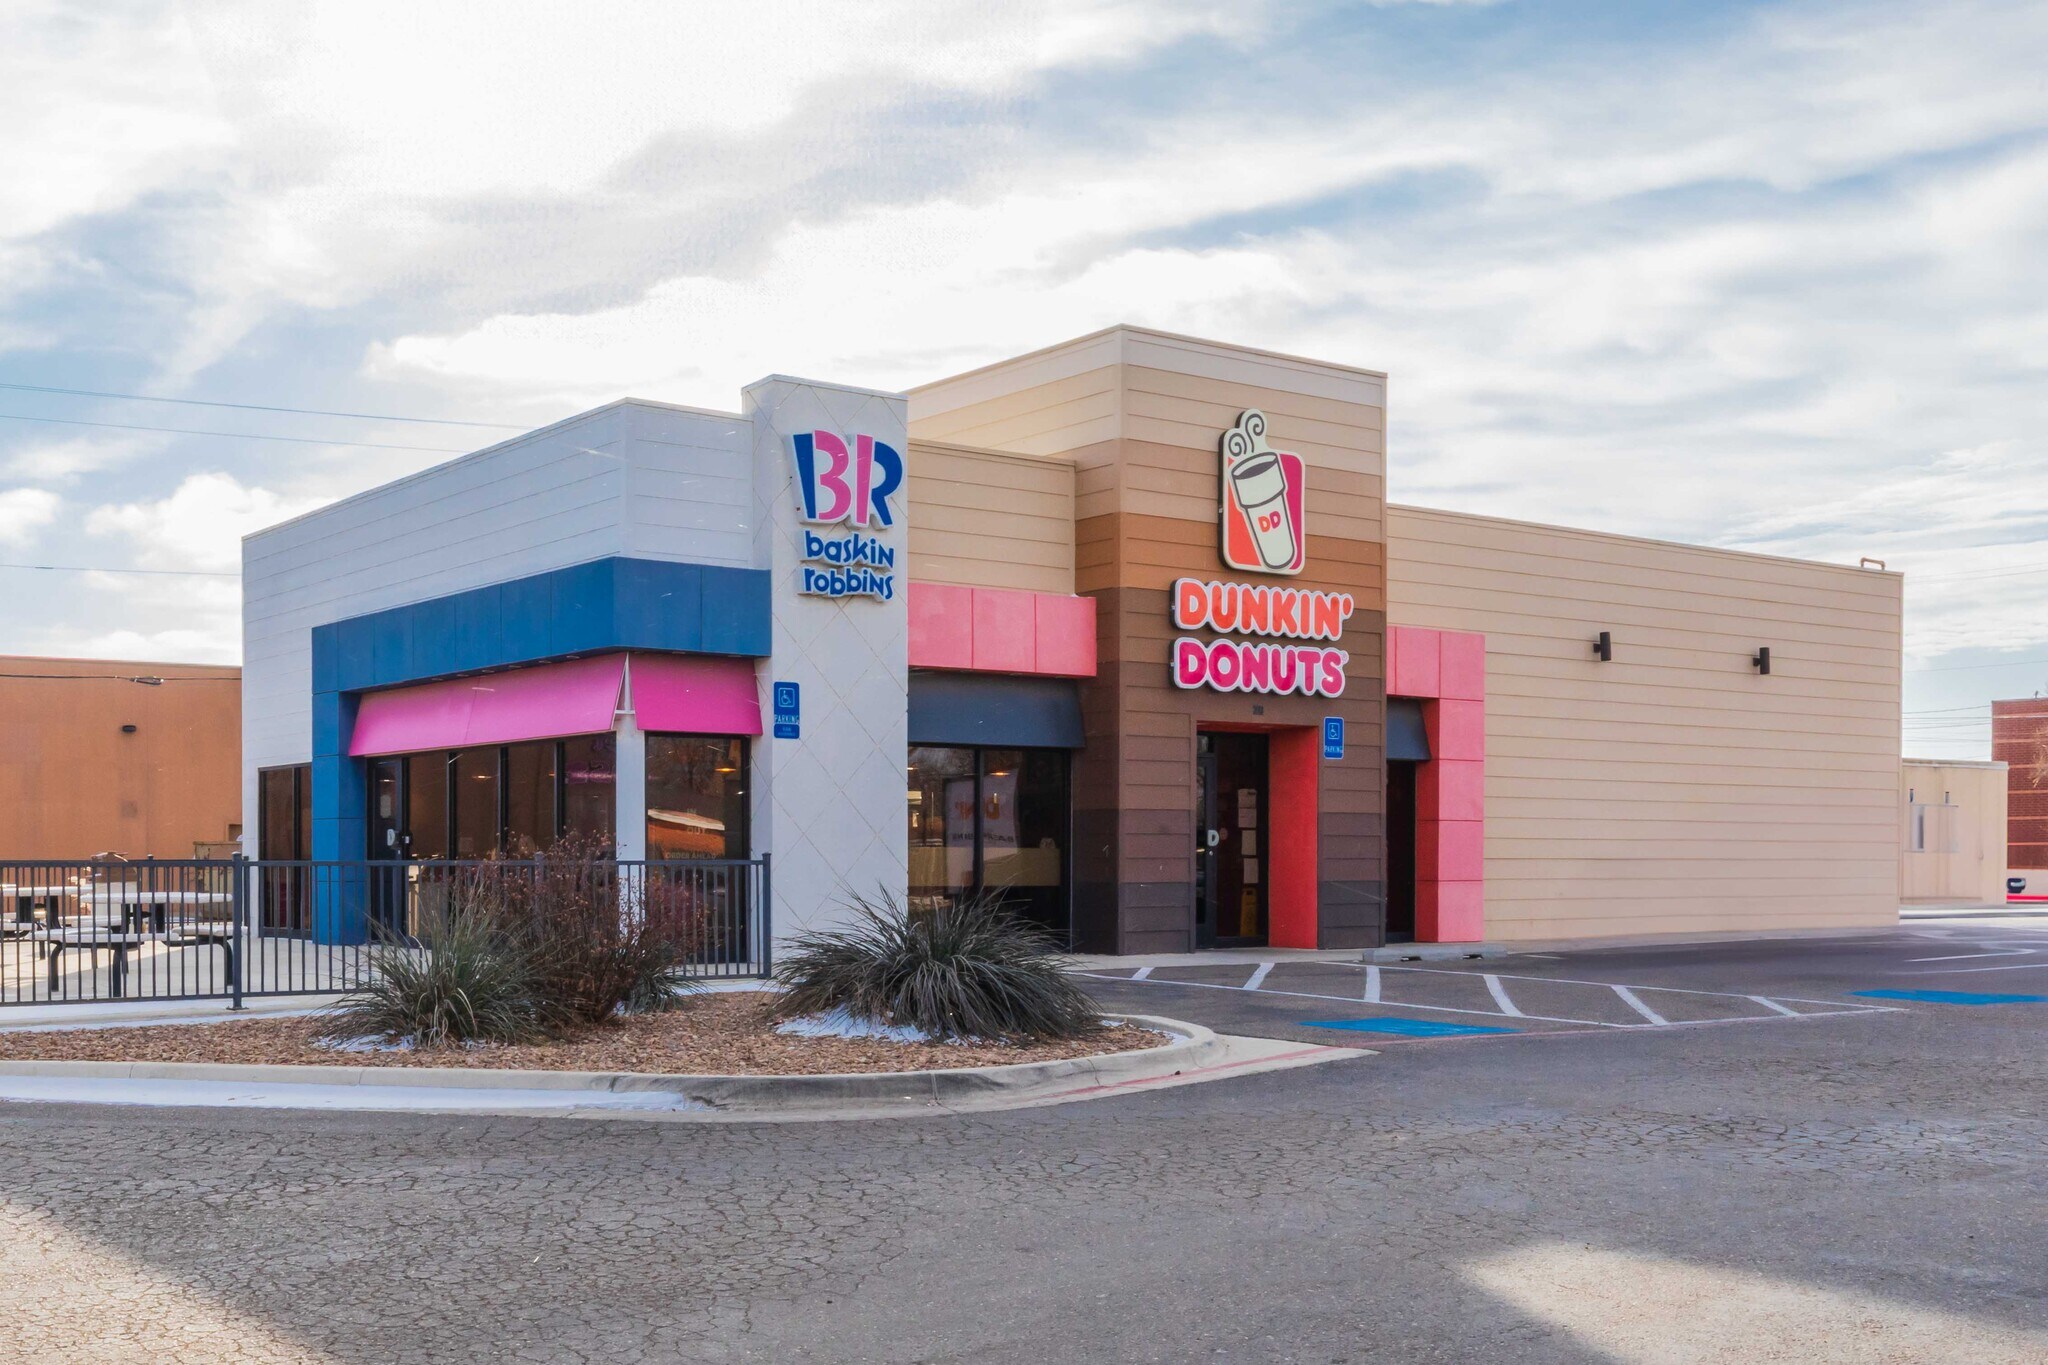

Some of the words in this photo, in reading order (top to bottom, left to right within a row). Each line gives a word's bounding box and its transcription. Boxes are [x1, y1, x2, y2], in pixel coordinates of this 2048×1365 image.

[793, 429, 903, 526] BR
[1257, 510, 1281, 533] DD
[1179, 581, 1352, 637] DUNKIN'
